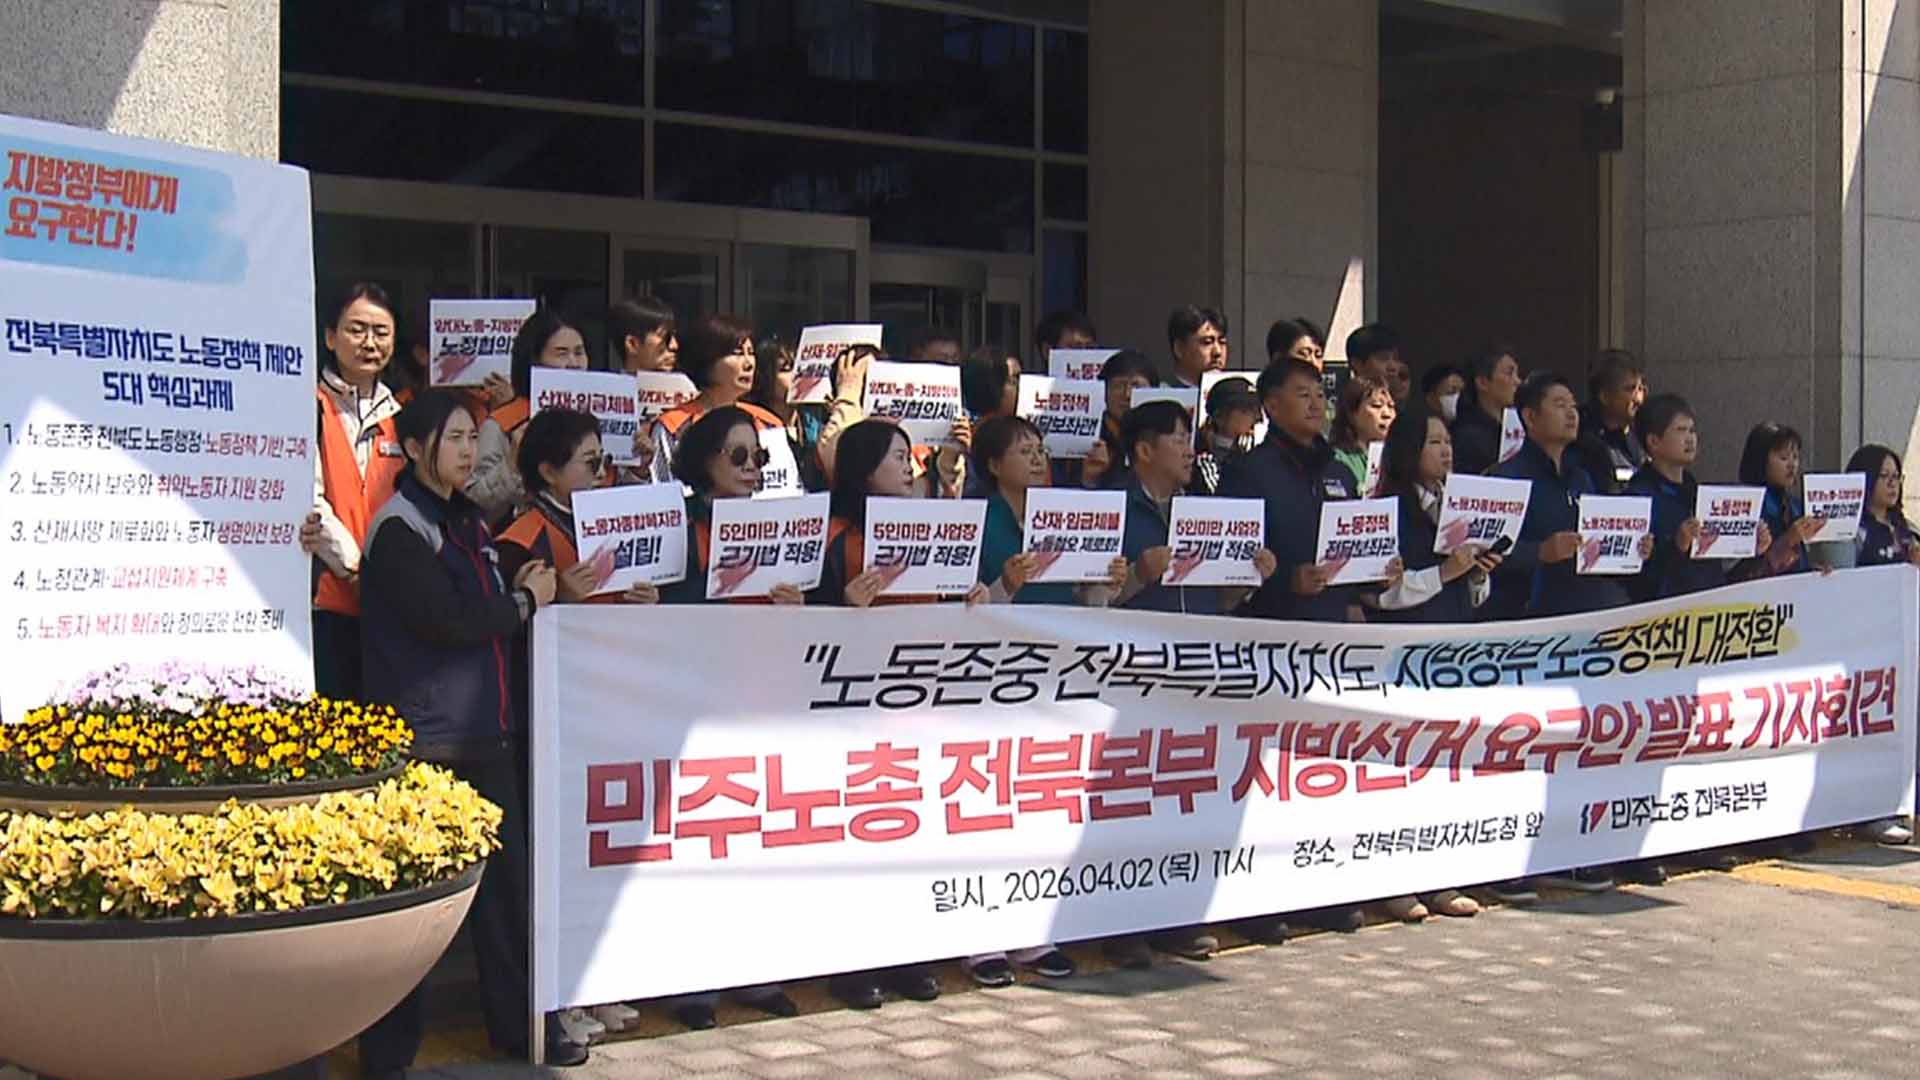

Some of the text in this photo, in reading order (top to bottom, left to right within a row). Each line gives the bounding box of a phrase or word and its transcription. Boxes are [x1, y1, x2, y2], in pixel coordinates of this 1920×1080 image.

[3, 152, 178, 214] 지방정부에게
[4, 197, 138, 252] 요구한다!
[5, 318, 304, 376] 전북특별자치도 노동정책 제안
[103, 371, 234, 412] 5대 핵심과제
[4, 423, 20, 446] 1.
[259, 434, 284, 459] 기반
[230, 476, 257, 500] 지원
[259, 477, 285, 502] 강화
[270, 521, 295, 545] 보장
[719, 516, 823, 542] 5인미만 사업장
[874, 522, 978, 542] 5인미만 사업장
[1176, 519, 1261, 537] 5인미만 사업장
[1466, 517, 1507, 539] 설립!
[614, 534, 663, 570] 설립!
[718, 540, 823, 569] 근기법 적용!
[874, 545, 977, 567] 근기법 적용!
[1174, 540, 1224, 561] 근기법
[1054, 640, 1389, 702] 전북특별자치도,
[1393, 640, 1542, 690] 지방정부
[1544, 615, 1691, 683] 노동정책
[586, 666, 1897, 868] 민주노총 전북본부 지방선거 요구안 발표 기자회견
[1612, 781, 1768, 830] 민주노총 전북본부
[1212, 846, 1256, 879] 11시
[1351, 816, 1517, 862] 전북특별자치도청
[1524, 811, 1544, 840] 앞
